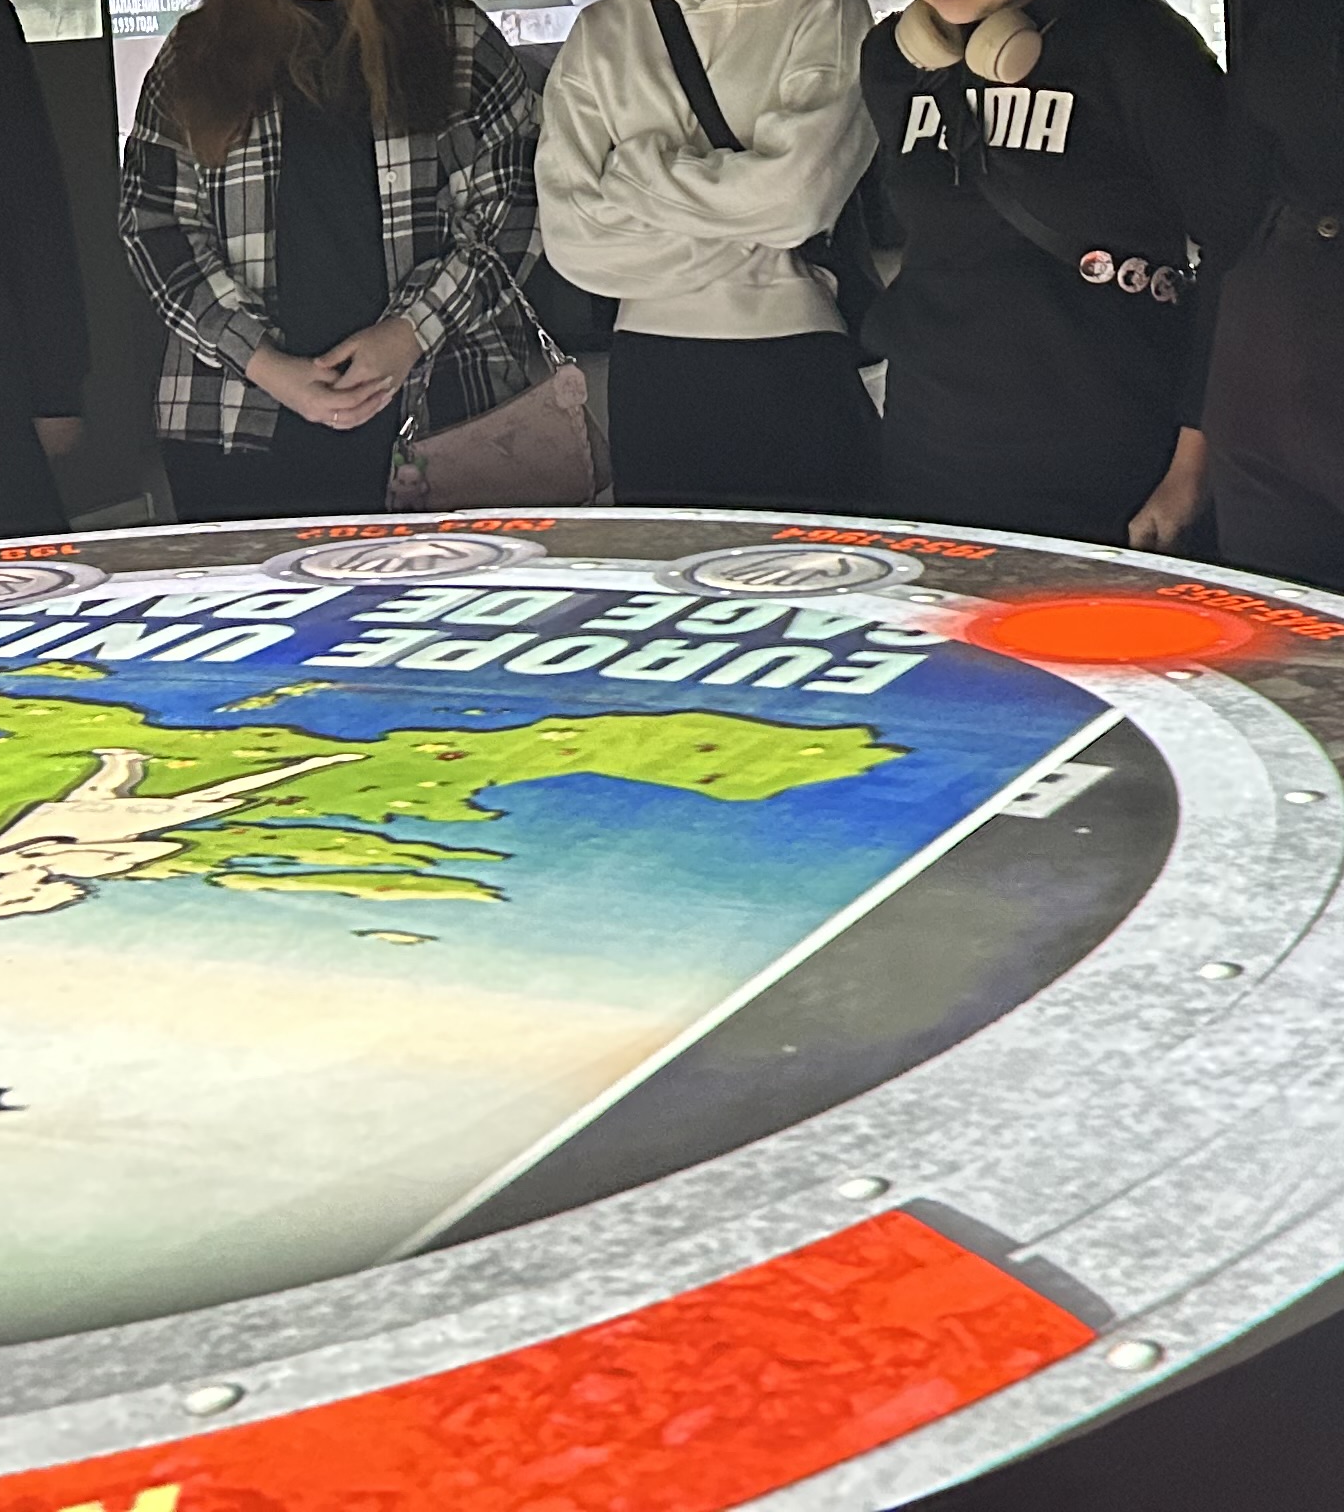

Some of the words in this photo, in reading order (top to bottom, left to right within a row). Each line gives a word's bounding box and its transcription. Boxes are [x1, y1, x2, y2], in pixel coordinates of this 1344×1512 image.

[112, 17, 135, 33] 1939
[136, 16, 159, 33] ГОДА
[771, 527, 997, 560] 1953-1964
[347, 585, 576, 626] DE
[301, 626, 929, 695] EUROPE
